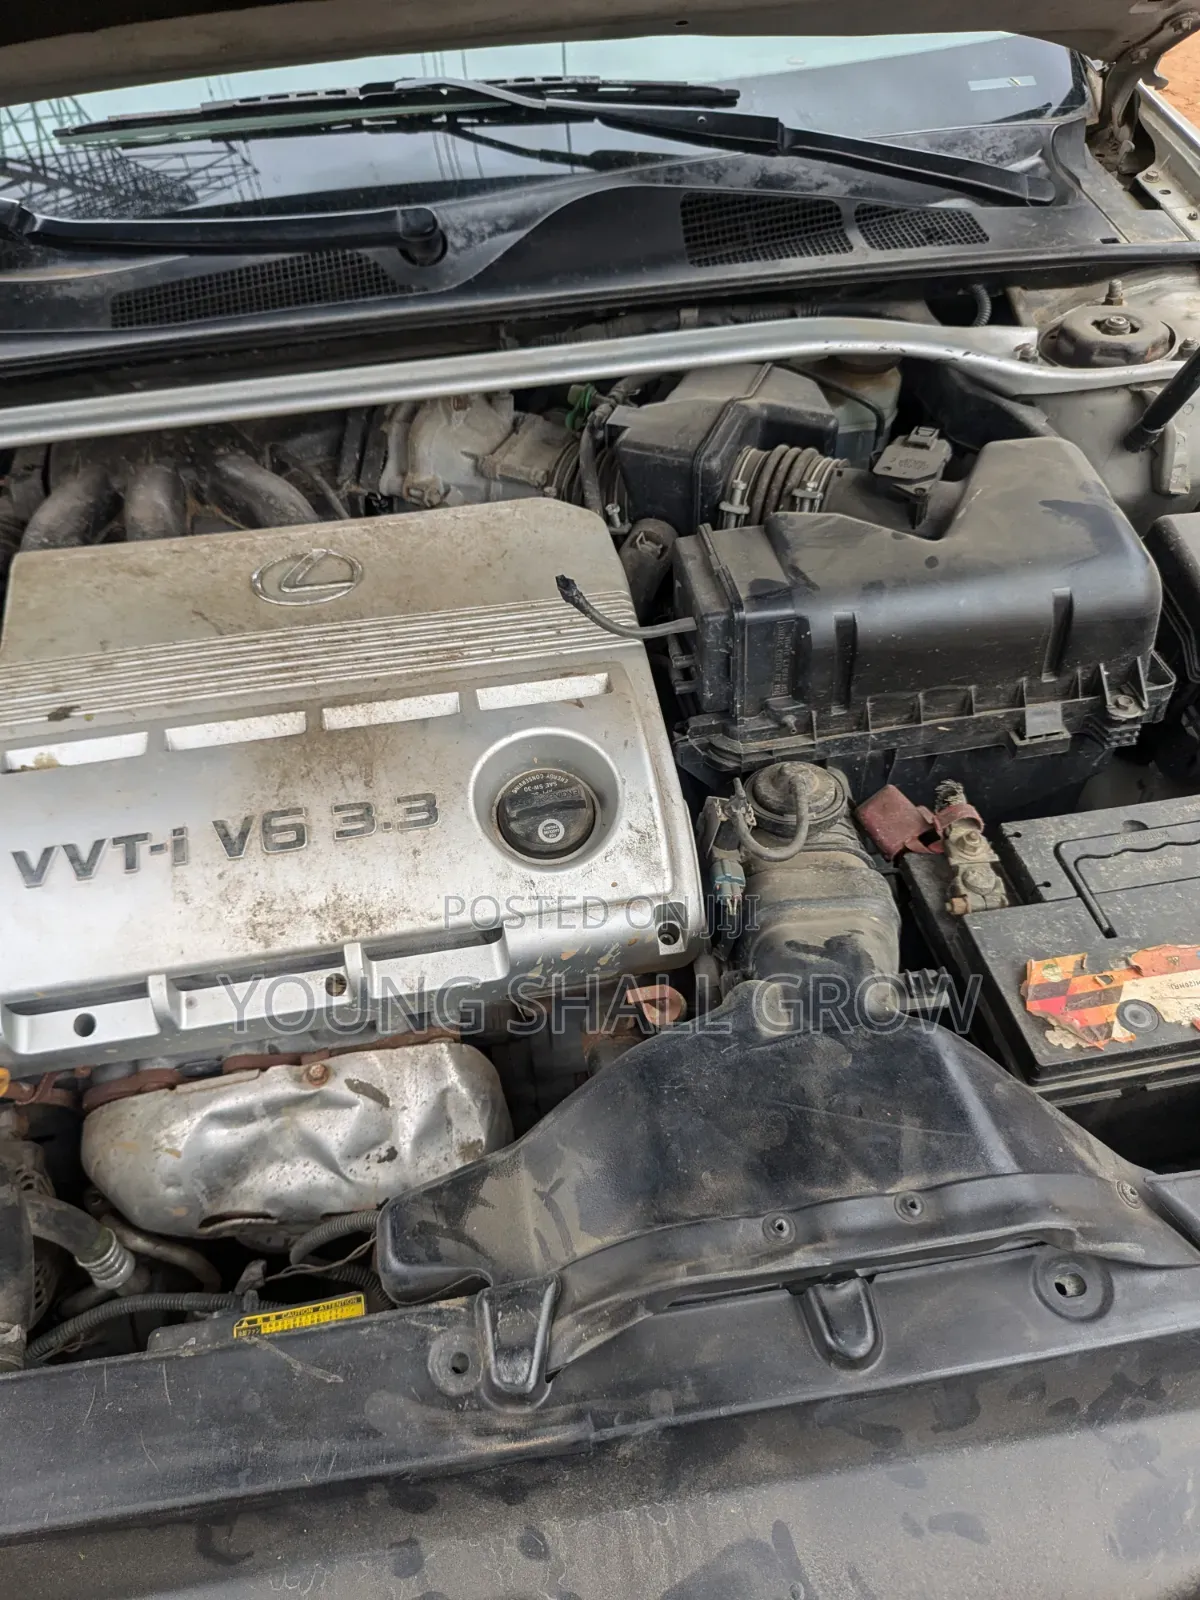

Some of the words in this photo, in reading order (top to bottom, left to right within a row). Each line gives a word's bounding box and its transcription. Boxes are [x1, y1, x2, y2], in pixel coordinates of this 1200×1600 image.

[511, 773, 544, 794] CONSERVING
[545, 773, 569, 784] ENERGY
[545, 781, 558, 789] SAE
[523, 783, 544, 793] 5W-30
[11, 826, 190, 888] VVT-i
[212, 807, 308, 861] V6
[332, 793, 441, 840] 3.3
[282, 1307, 313, 1319] CAUTION
[319, 1297, 358, 1312] ATTENTION
